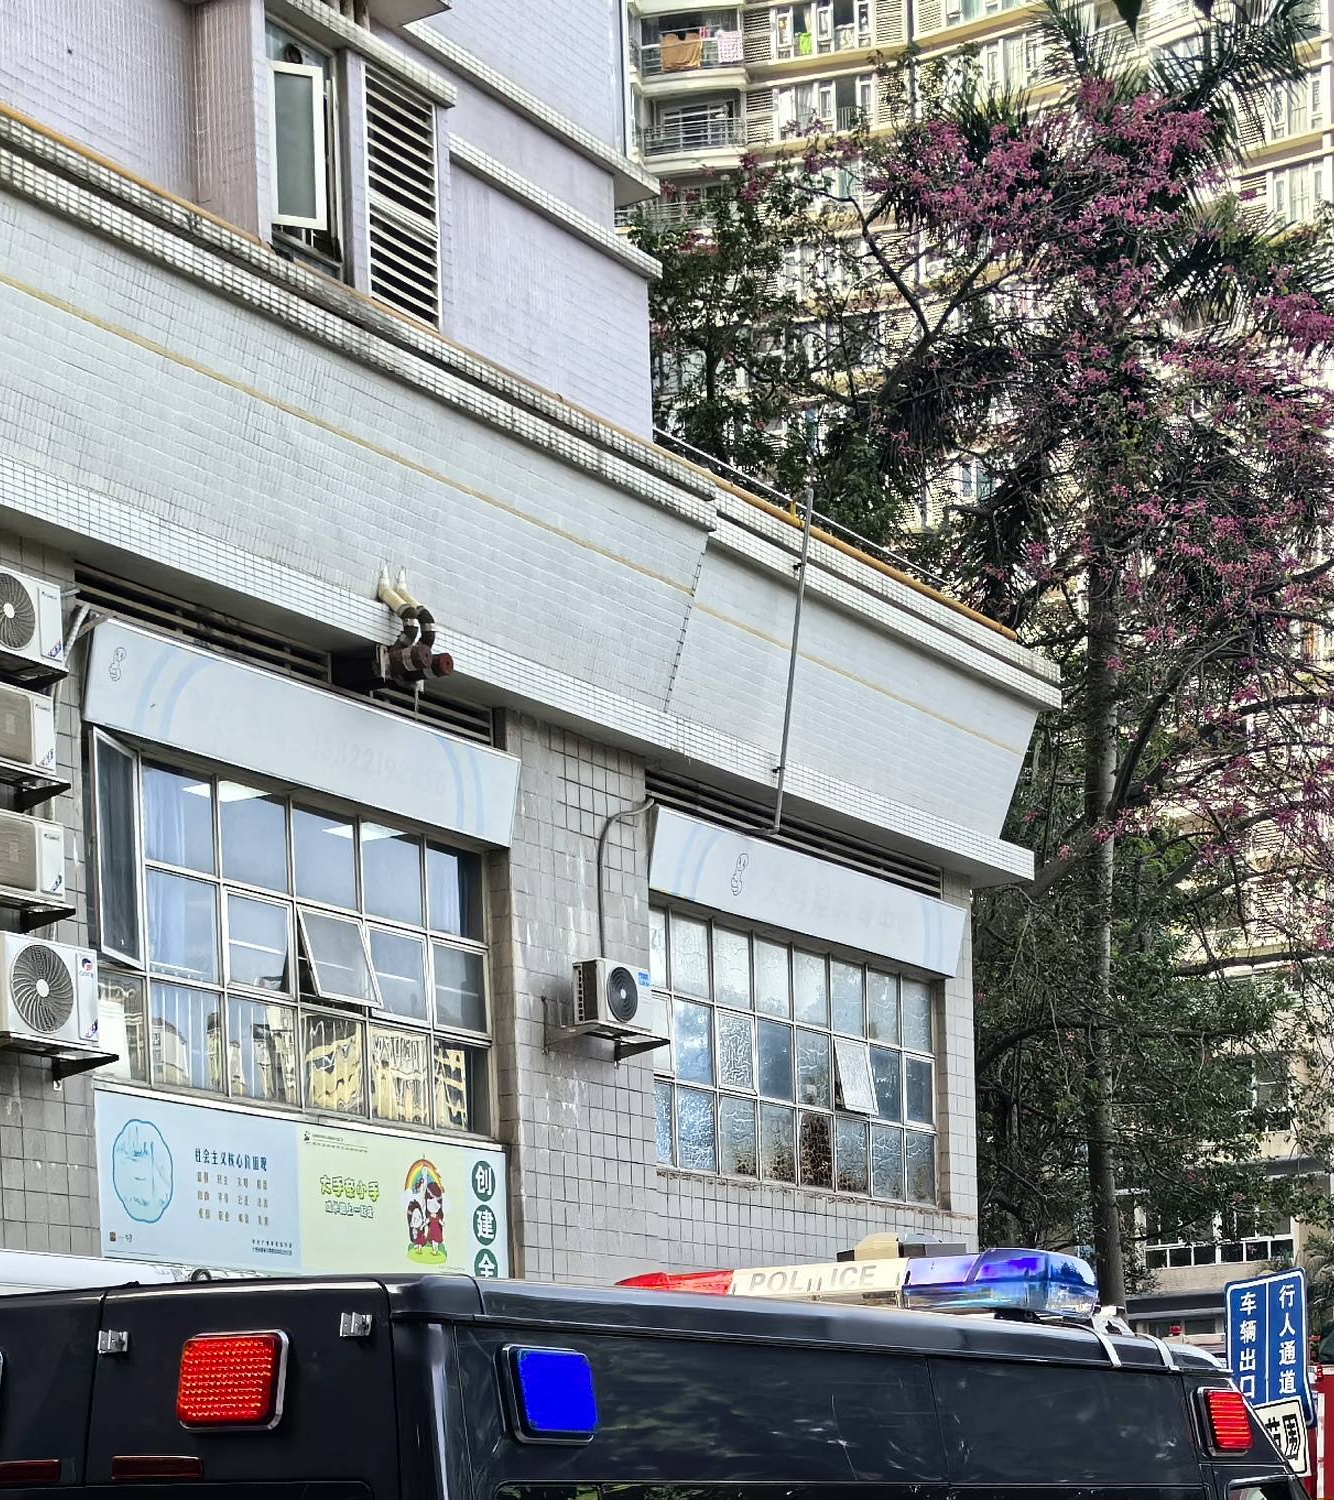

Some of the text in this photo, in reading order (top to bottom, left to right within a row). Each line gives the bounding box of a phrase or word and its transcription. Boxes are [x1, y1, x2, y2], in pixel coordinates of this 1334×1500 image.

[749, 1264, 877, 1292] POLICE
[1238, 1291, 1257, 1400] 车辆出口
[1278, 1284, 1297, 1395] 行人通道
